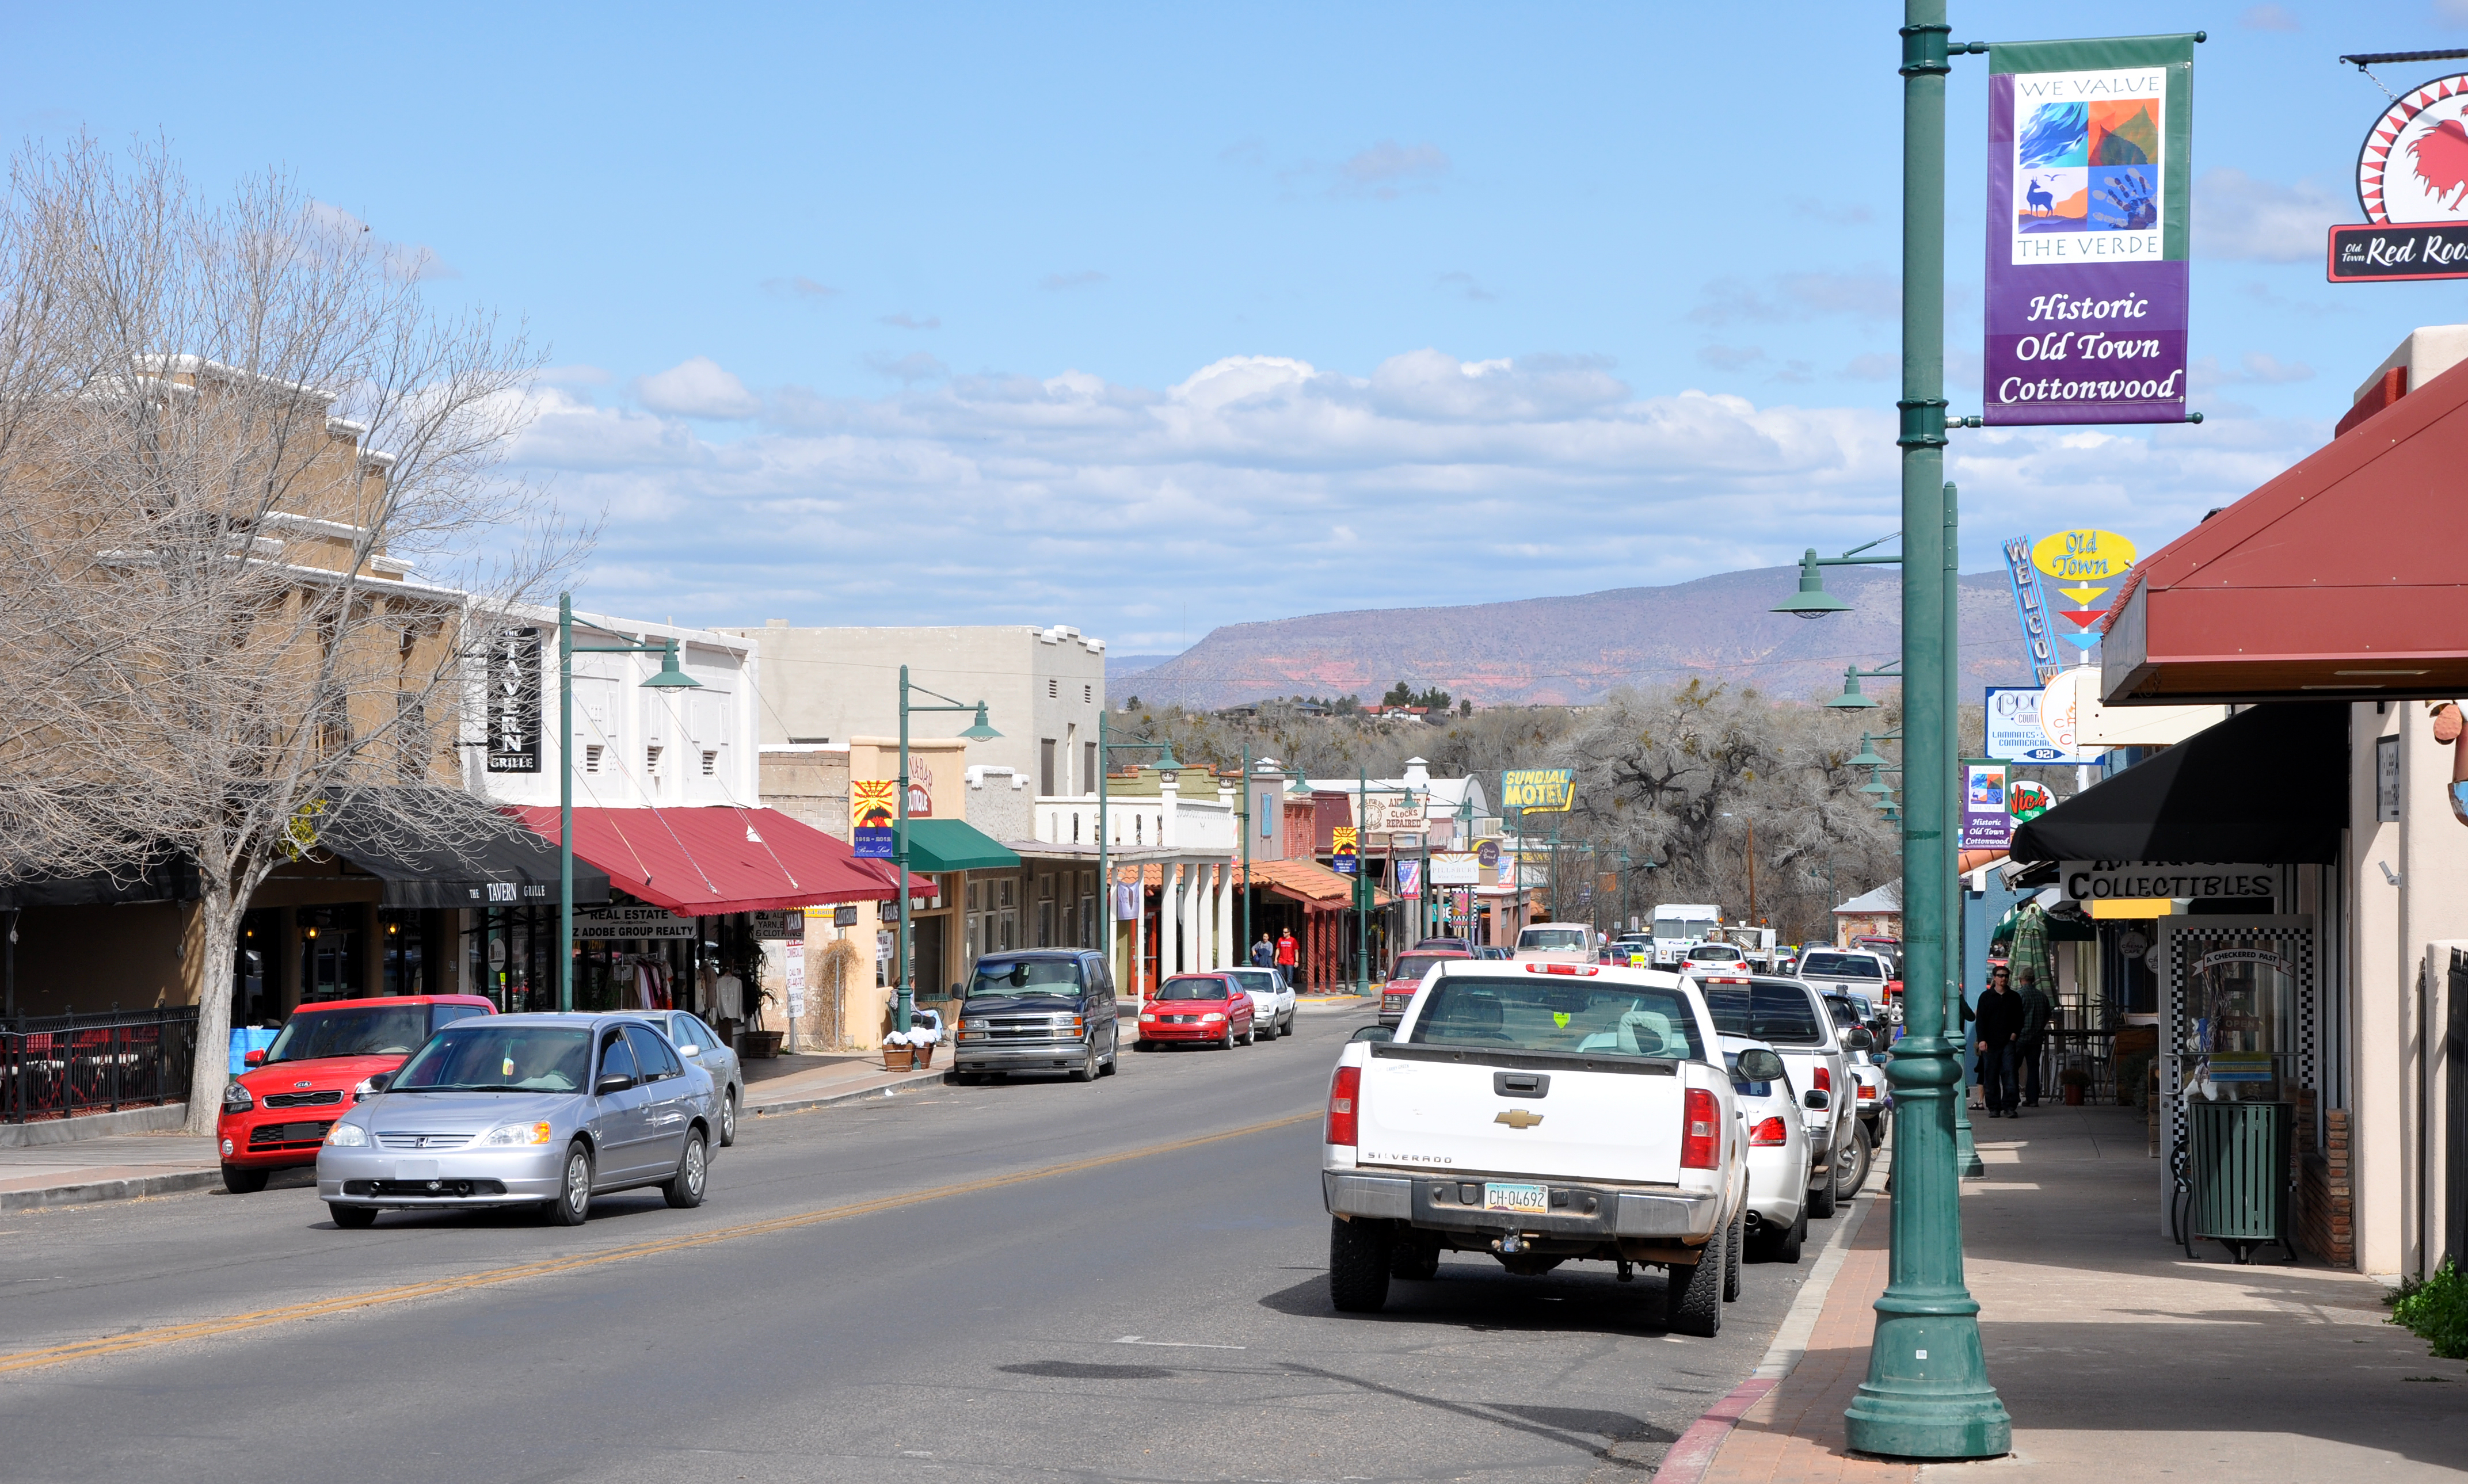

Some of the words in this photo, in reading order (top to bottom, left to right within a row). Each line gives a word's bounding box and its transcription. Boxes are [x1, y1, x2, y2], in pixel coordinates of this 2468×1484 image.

[2020, 81, 2064, 98] WE
[2073, 76, 2161, 96] VALUE
[2017, 239, 2066, 257] THE
[2077, 235, 2158, 255] VERDE
[2345, 243, 2362, 253] Old
[2366, 237, 2416, 266] Red
[2342, 253, 2366, 262] Town
[2027, 292, 2149, 322] Historic
[2016, 331, 2073, 362] Old
[2075, 332, 2161, 360] Town
[1999, 369, 2184, 404] Cottonwood
[2066, 531, 2098, 554] Old
[2052, 553, 2109, 576] Town
[501, 642, 524, 751] TAVERN
[2036, 749, 2054, 758] 921
[490, 757, 534, 768] GRILLE
[1505, 770, 1568, 784] SUNDIAL
[1504, 784, 1566, 806] MOTEL
[1391, 809, 1418, 818] CLOCKS
[1386, 819, 1422, 827] REPAIRED
[1985, 827, 2005, 836] Town
[469, 889, 480, 899] THE
[487, 883, 517, 902] TAVERN
[524, 885, 546, 897] GRILLE
[2068, 872, 2273, 900] COLLECTIBLES
[591, 910, 620, 920] REAL
[624, 909, 668, 920] ESTATE
[786, 913, 802, 930] YARN
[835, 908, 856, 925] CLOTHING
[582, 927, 615, 937] ADOBE
[618, 926, 653, 936] GROUP
[656, 926, 694, 936] REALTY
[2214, 951, 2256, 961] CHECKERED
[2258, 953, 2277, 963] PAST
[2225, 1020, 2254, 1028] OPEN
[1368, 1152, 1452, 1163] SILVERADO
